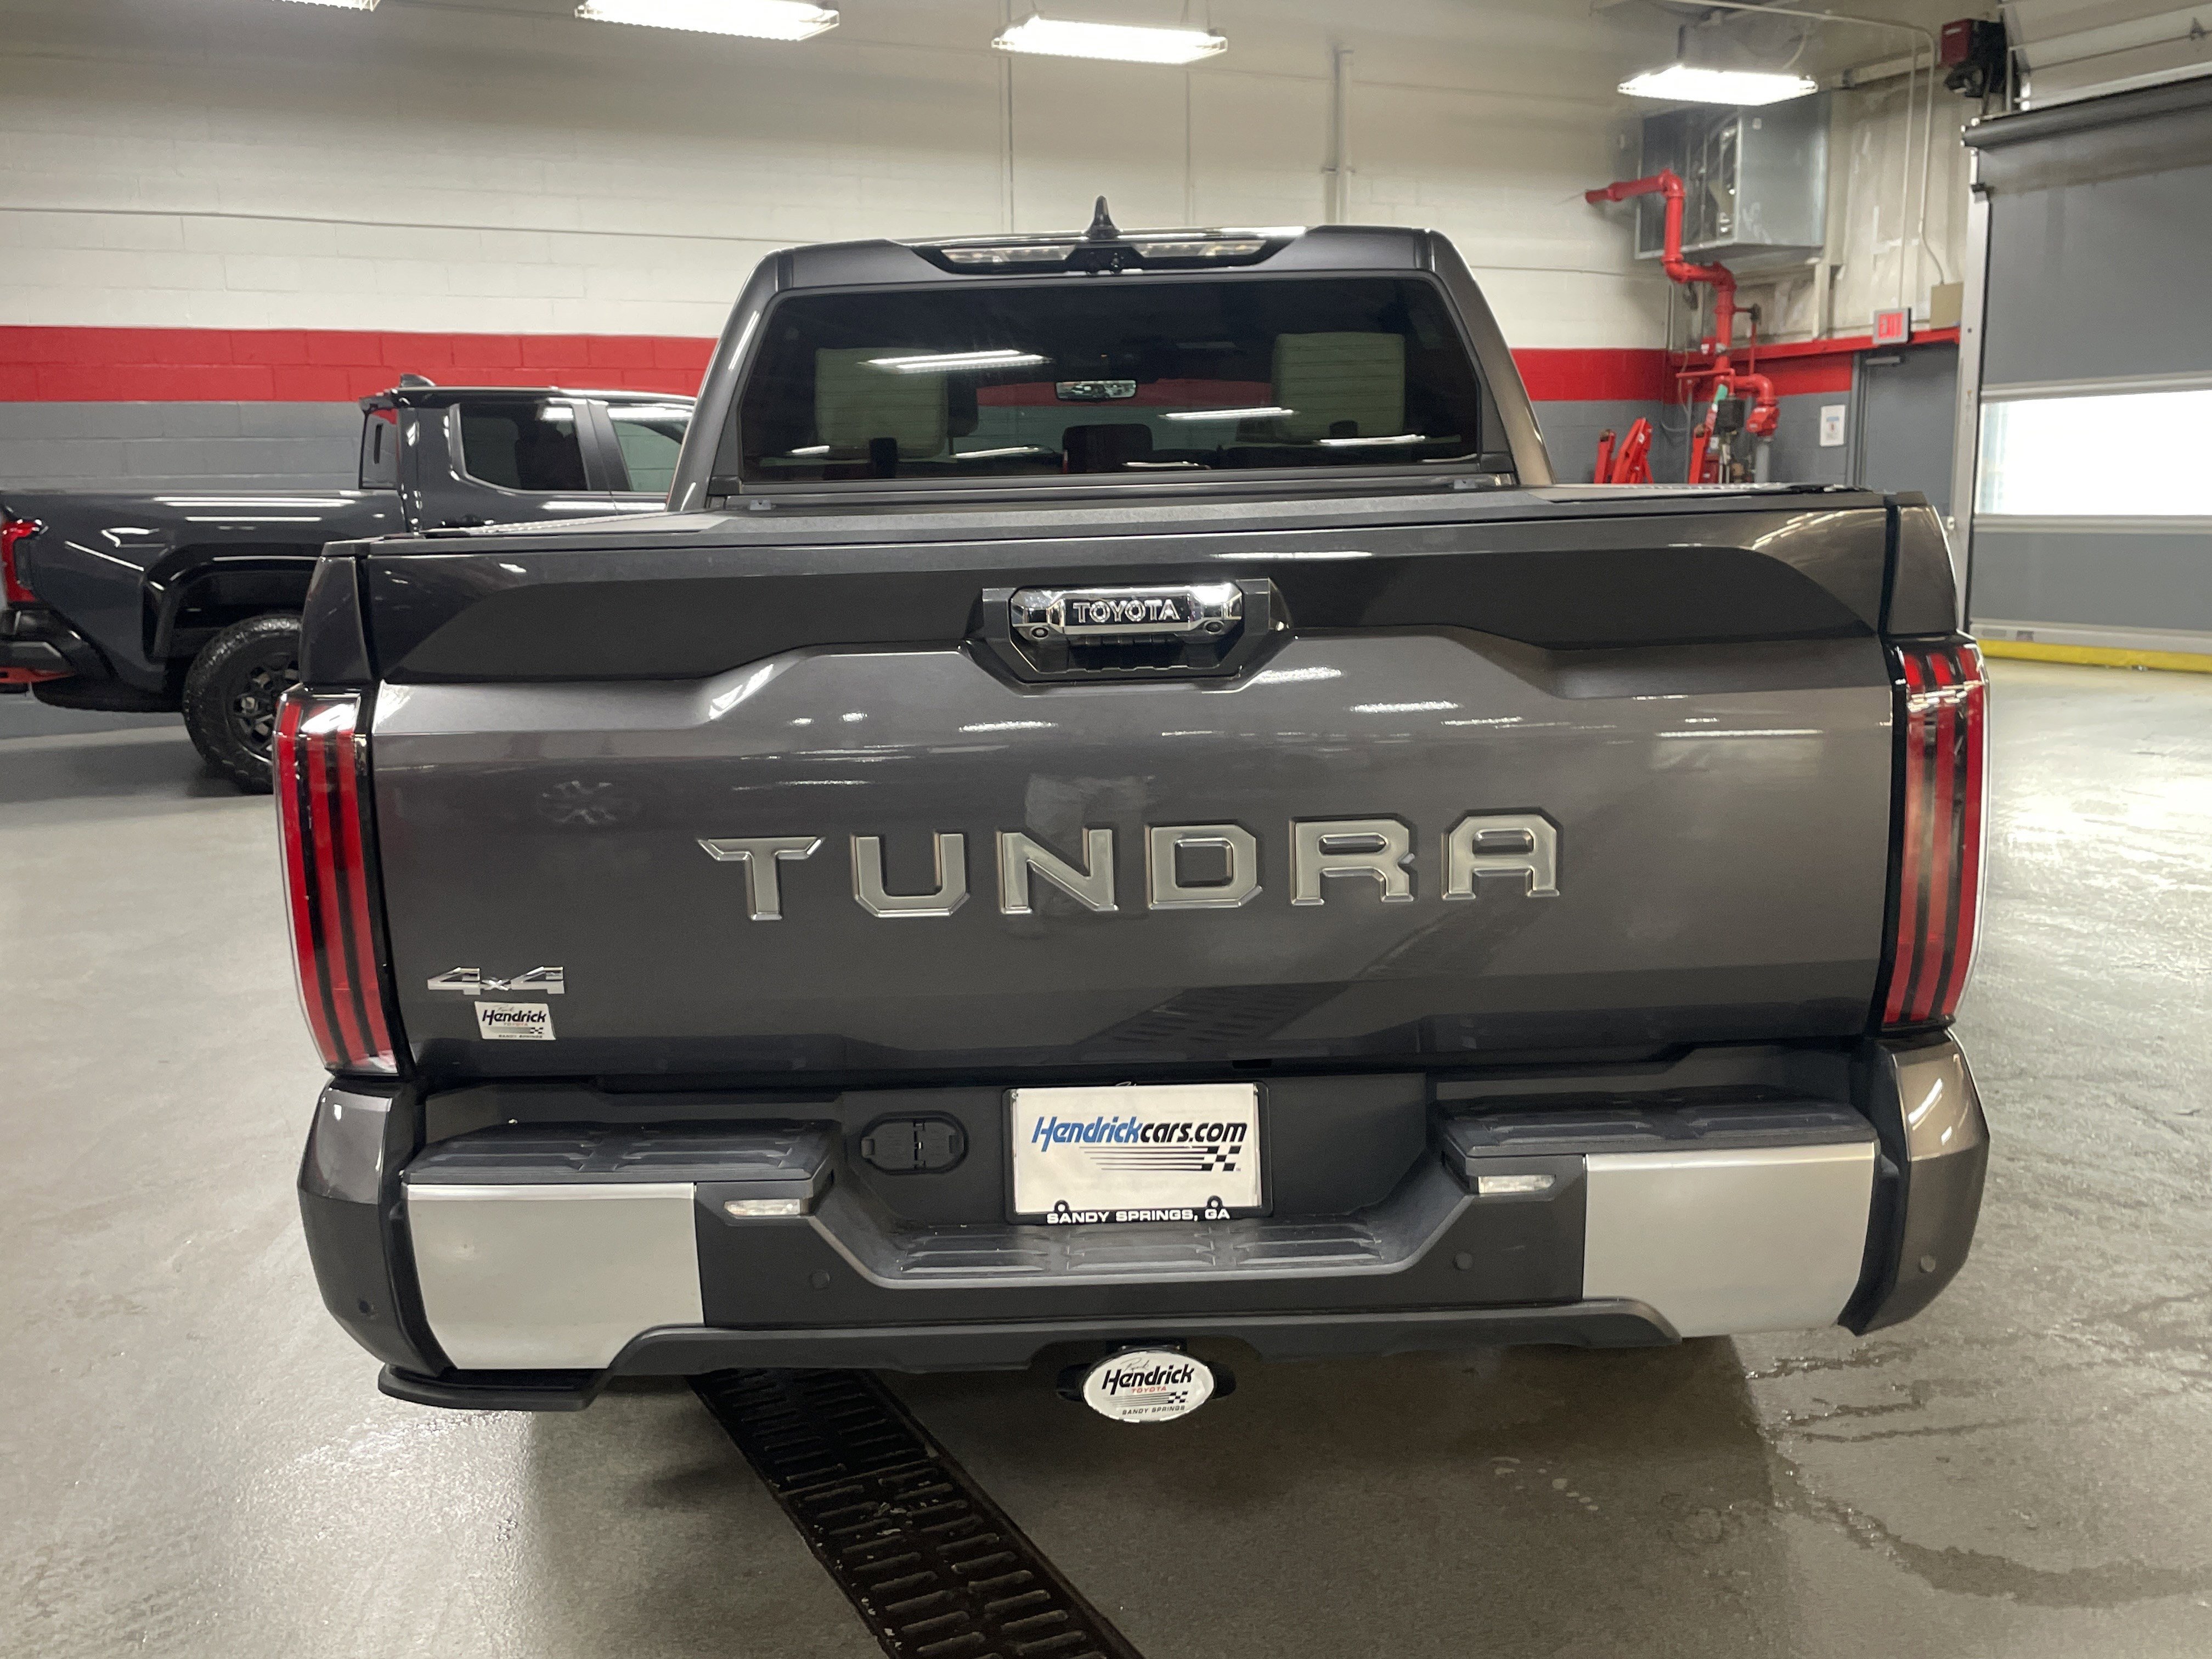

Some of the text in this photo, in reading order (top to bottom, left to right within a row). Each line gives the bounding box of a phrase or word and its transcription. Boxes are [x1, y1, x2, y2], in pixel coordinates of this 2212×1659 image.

[1073, 599, 1181, 623] TOYOTA
[697, 811, 1563, 922] TUNDRA
[482, 1009, 546, 1025] Hendrick
[1031, 1116, 1248, 1152] Hendrickcars.com
[1047, 1207, 1231, 1224] SANDY SPRINGS, GA
[1102, 1363, 1195, 1395] Hendrick
